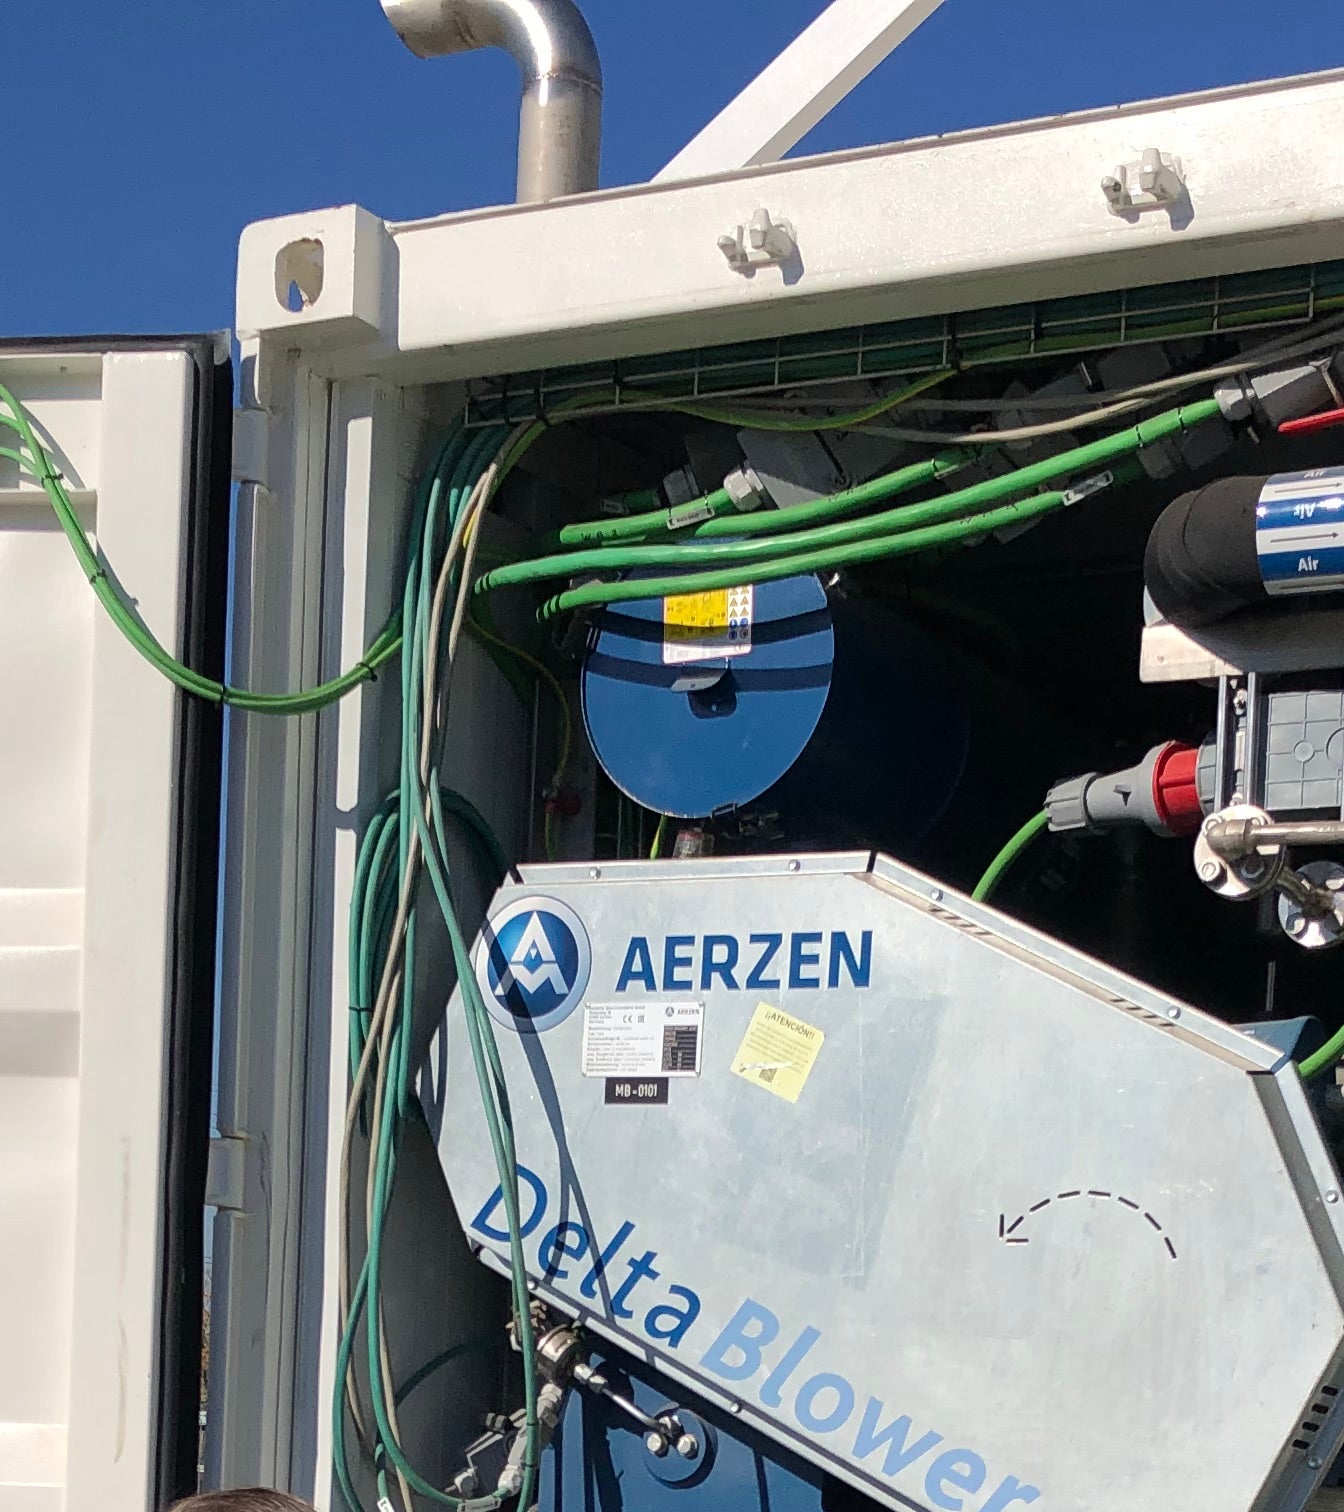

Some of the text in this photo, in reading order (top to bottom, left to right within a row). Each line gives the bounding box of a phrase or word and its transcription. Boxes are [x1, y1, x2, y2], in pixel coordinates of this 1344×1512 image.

[1297, 555, 1320, 572] Air
[615, 930, 873, 992] AERZEN
[614, 1082, 658, 1098] MB-0101
[470, 1163, 701, 1349] Delta
